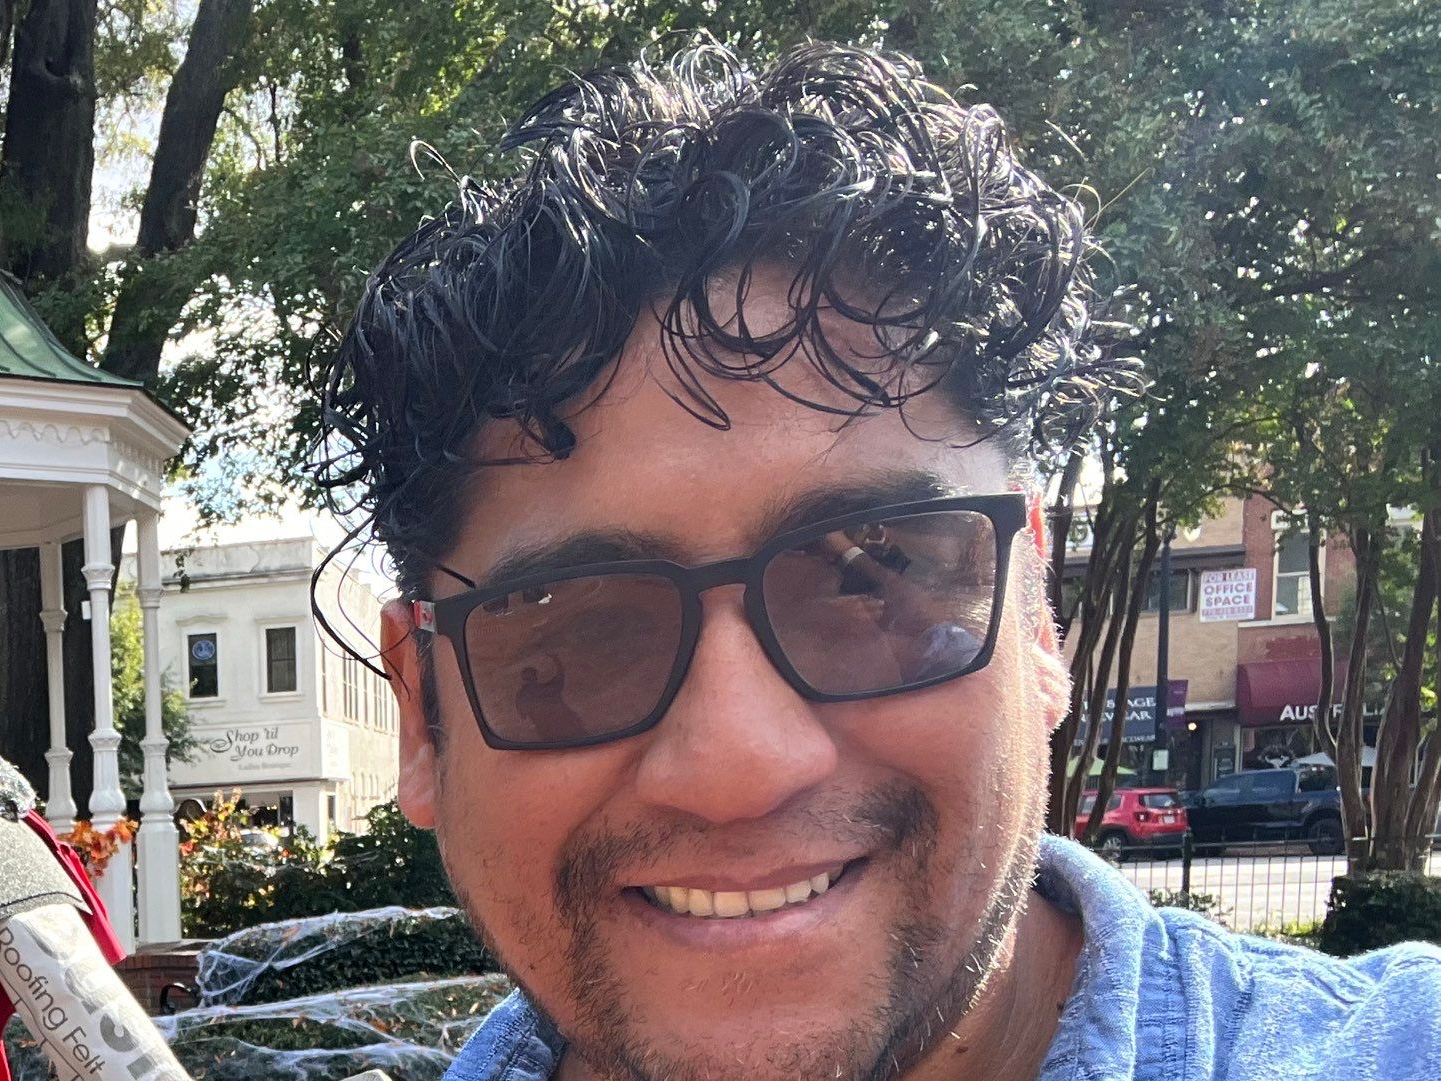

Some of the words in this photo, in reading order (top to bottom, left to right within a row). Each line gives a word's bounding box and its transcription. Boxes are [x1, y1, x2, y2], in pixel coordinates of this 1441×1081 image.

[1204, 581, 1253, 595] OFFICE
[1205, 595, 1251, 607] SPACE
[210, 730, 259, 754] Shop
[230, 743, 264, 762] You
[266, 742, 299, 758] Drop
[62, 1026, 106, 1075] Felt
